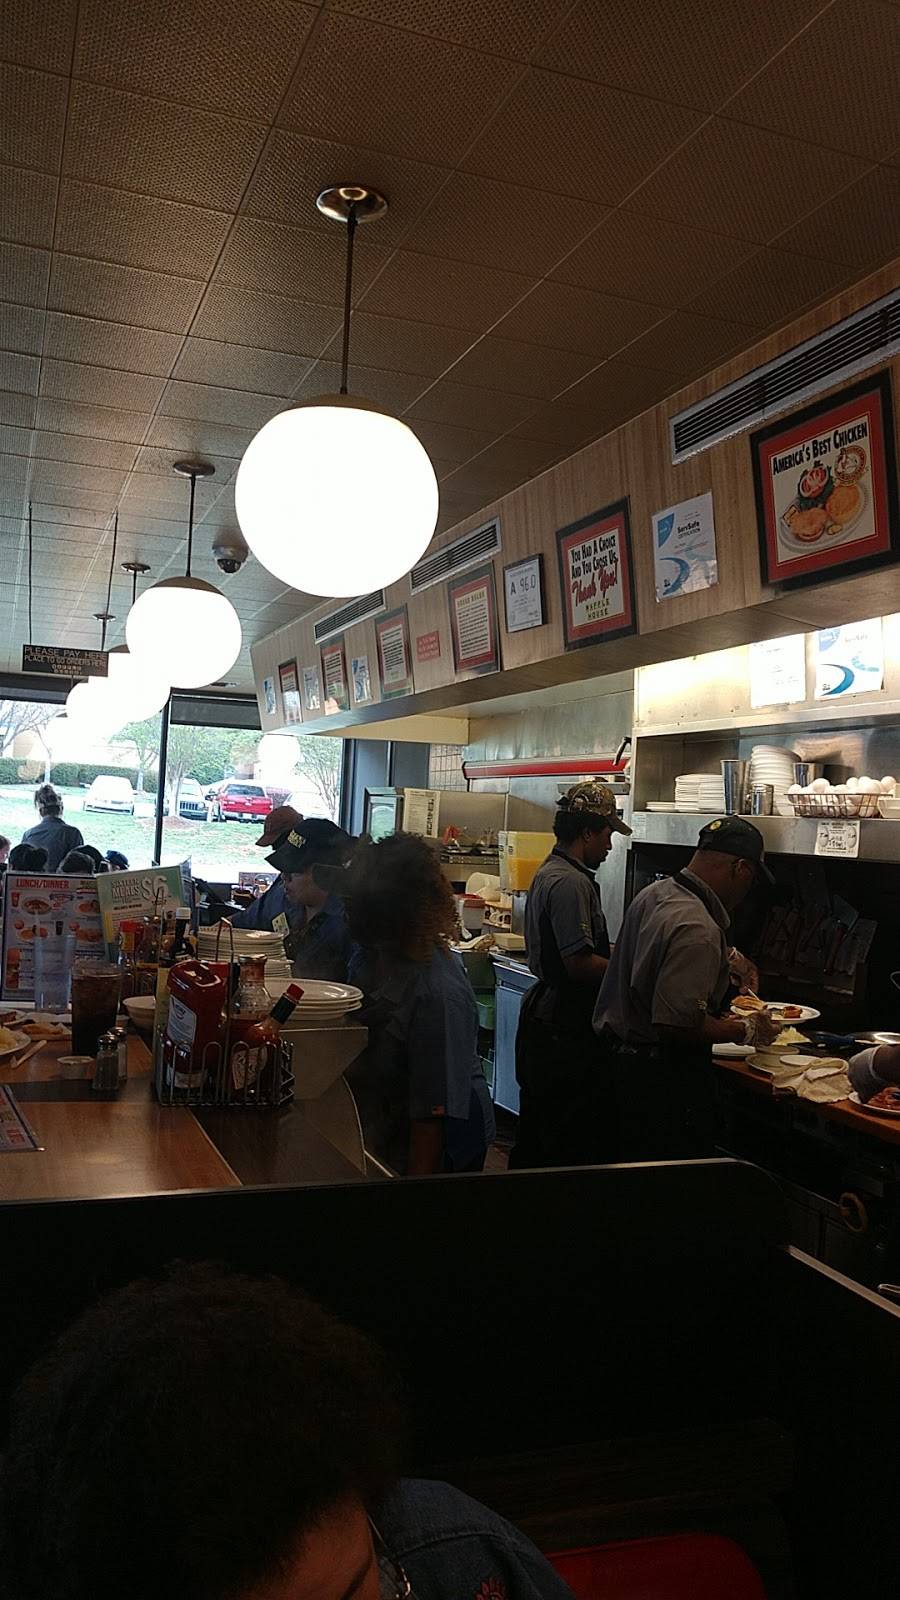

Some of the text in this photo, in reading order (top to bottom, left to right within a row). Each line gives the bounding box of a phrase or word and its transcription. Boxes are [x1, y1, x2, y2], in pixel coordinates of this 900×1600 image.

[773, 422, 868, 476] AMERICA'S BEST CHICKEN
[571, 535, 616, 564] YOU HAD A CHOICE
[571, 564, 582, 580] AND
[582, 560, 592, 576] YOU
[592, 555, 609, 571] CHOSE
[510, 581, 517, 596] A
[572, 572, 597, 607] Thank
[587, 607, 609, 620] HOUSE
[24, 646, 60, 657] PLEASE
[84, 652, 107, 660] HERE
[66, 658, 90, 666] ORDERS
[15, 877, 70, 889] LUNCH/DINNER
[112, 885, 141, 897] MEALS
